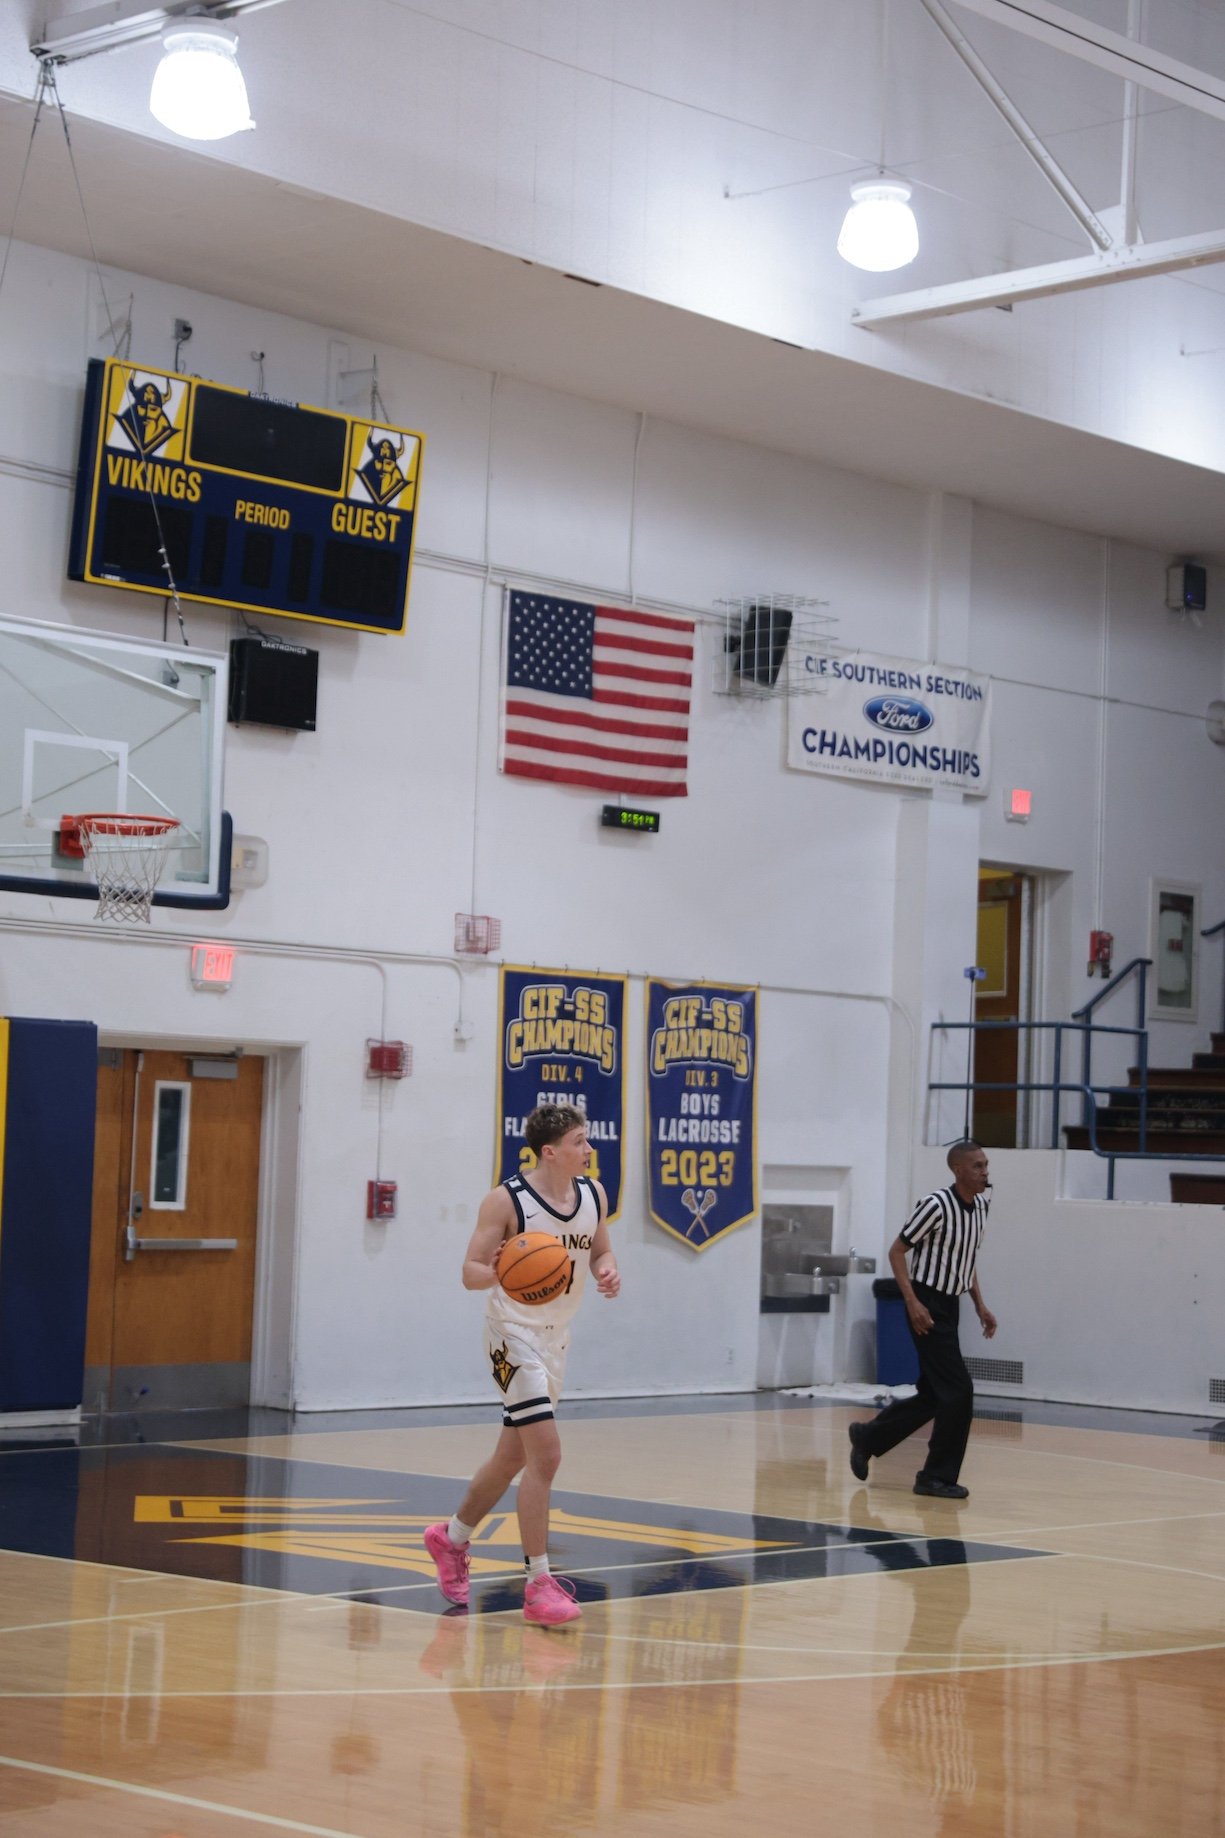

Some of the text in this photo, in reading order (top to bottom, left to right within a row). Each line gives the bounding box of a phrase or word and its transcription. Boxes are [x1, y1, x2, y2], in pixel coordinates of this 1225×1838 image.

[106, 454, 202, 502] VIKINGS
[234, 499, 290, 530] PERIOD
[331, 502, 401, 542] GUEST
[261, 641, 307, 655] DAKTRONICS
[832, 661, 921, 690] SOUTHERN
[926, 675, 982, 700] SECTION
[876, 701, 921, 729] Ford
[802, 727, 980, 778] CHAMPIONSHIPS
[205, 951, 233, 978] EXIT
[522, 986, 606, 1026] CIF-SS
[665, 998, 741, 1033] CIF-SS
[508, 1018, 614, 1070] CHAMPIONS
[654, 1028, 748, 1076] CHAMPIONS
[541, 1064, 583, 1082] DIV. 4
[685, 1069, 718, 1087] DIV. 3
[680, 1092, 720, 1115] BOYS
[658, 1117, 741, 1144] LACROSSE
[660, 1149, 735, 1187] 2023
[521, 1274, 566, 1301] Wilson
